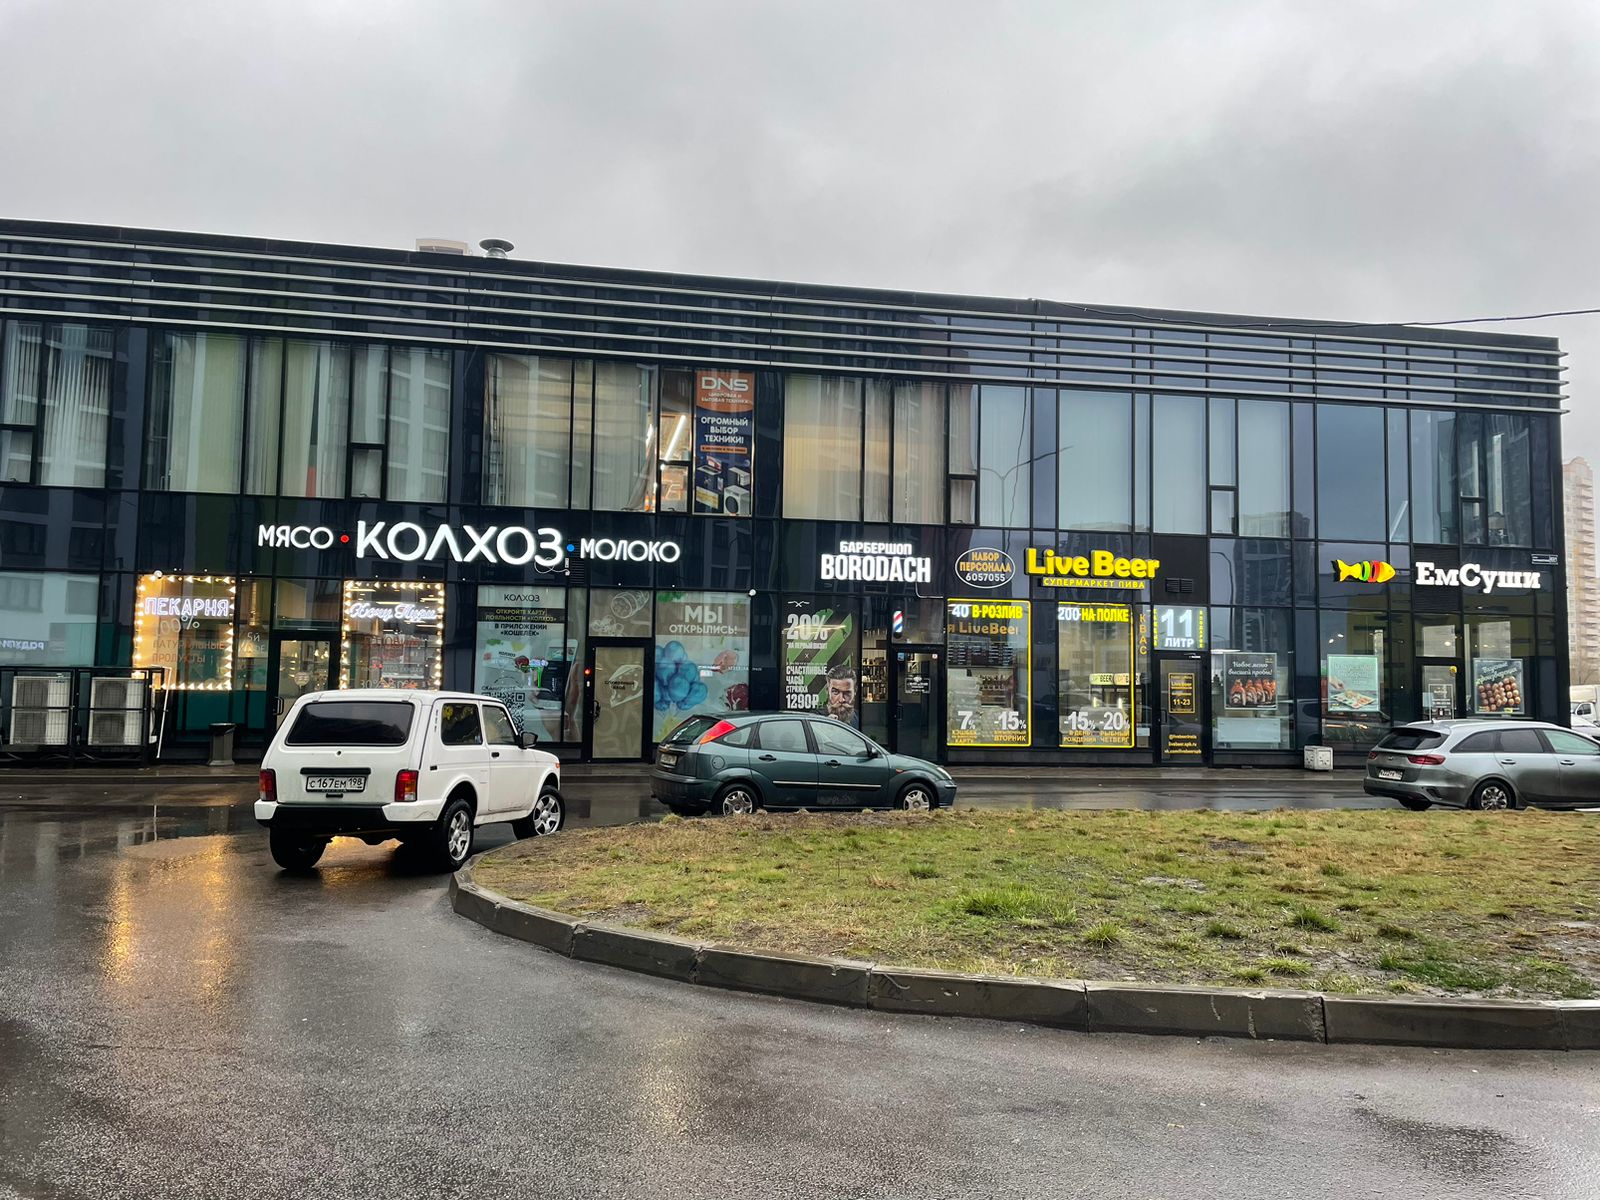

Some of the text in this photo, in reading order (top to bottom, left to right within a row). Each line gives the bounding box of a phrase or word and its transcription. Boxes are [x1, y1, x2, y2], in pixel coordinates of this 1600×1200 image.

[701, 376, 749, 392] DNS
[701, 416, 749, 427] ОГРОМНЫЙ
[710, 426, 739, 435] ВЫБОР
[705, 434, 744, 444] ТЕХНИКИ!
[257, 520, 681, 567] МЯСО КОЛХОЗ МОЛОКО
[839, 541, 913, 555] БАРБЕРШОП
[971, 551, 1000, 562] НАБОР
[821, 554, 931, 583] BORODACH
[959, 562, 1012, 573] ПЕРСОНАЛА
[1025, 547, 1160, 579] Live Beer
[965, 573, 1006, 582] 6057055
[1415, 562, 1541, 594] ЕмСуши
[1043, 579, 1145, 589] СУПЕРМАРКЕТ ПИВА
[504, 593, 540, 603] КОЛХОЗ
[144, 597, 229, 617] ПЕКАРНЯ
[952, 604, 969, 618] 40
[684, 605, 723, 624] МЫ
[1058, 607, 1129, 622] 200 НА ПОЛКЕ
[787, 613, 828, 641] 20%
[1161, 608, 1193, 638] 11
[669, 624, 738, 635] ОТКРЫЛИСЬ!
[1164, 637, 1195, 648] ЛИТР
[786, 665, 828, 675] СЧАСТЛИВЫЕ
[786, 675, 804, 685] ЧАСЫ
[786, 685, 809, 693] СТРИЖКА
[1173, 698, 1191, 706] 11-23
[1064, 711, 1131, 731] -15% -20%
